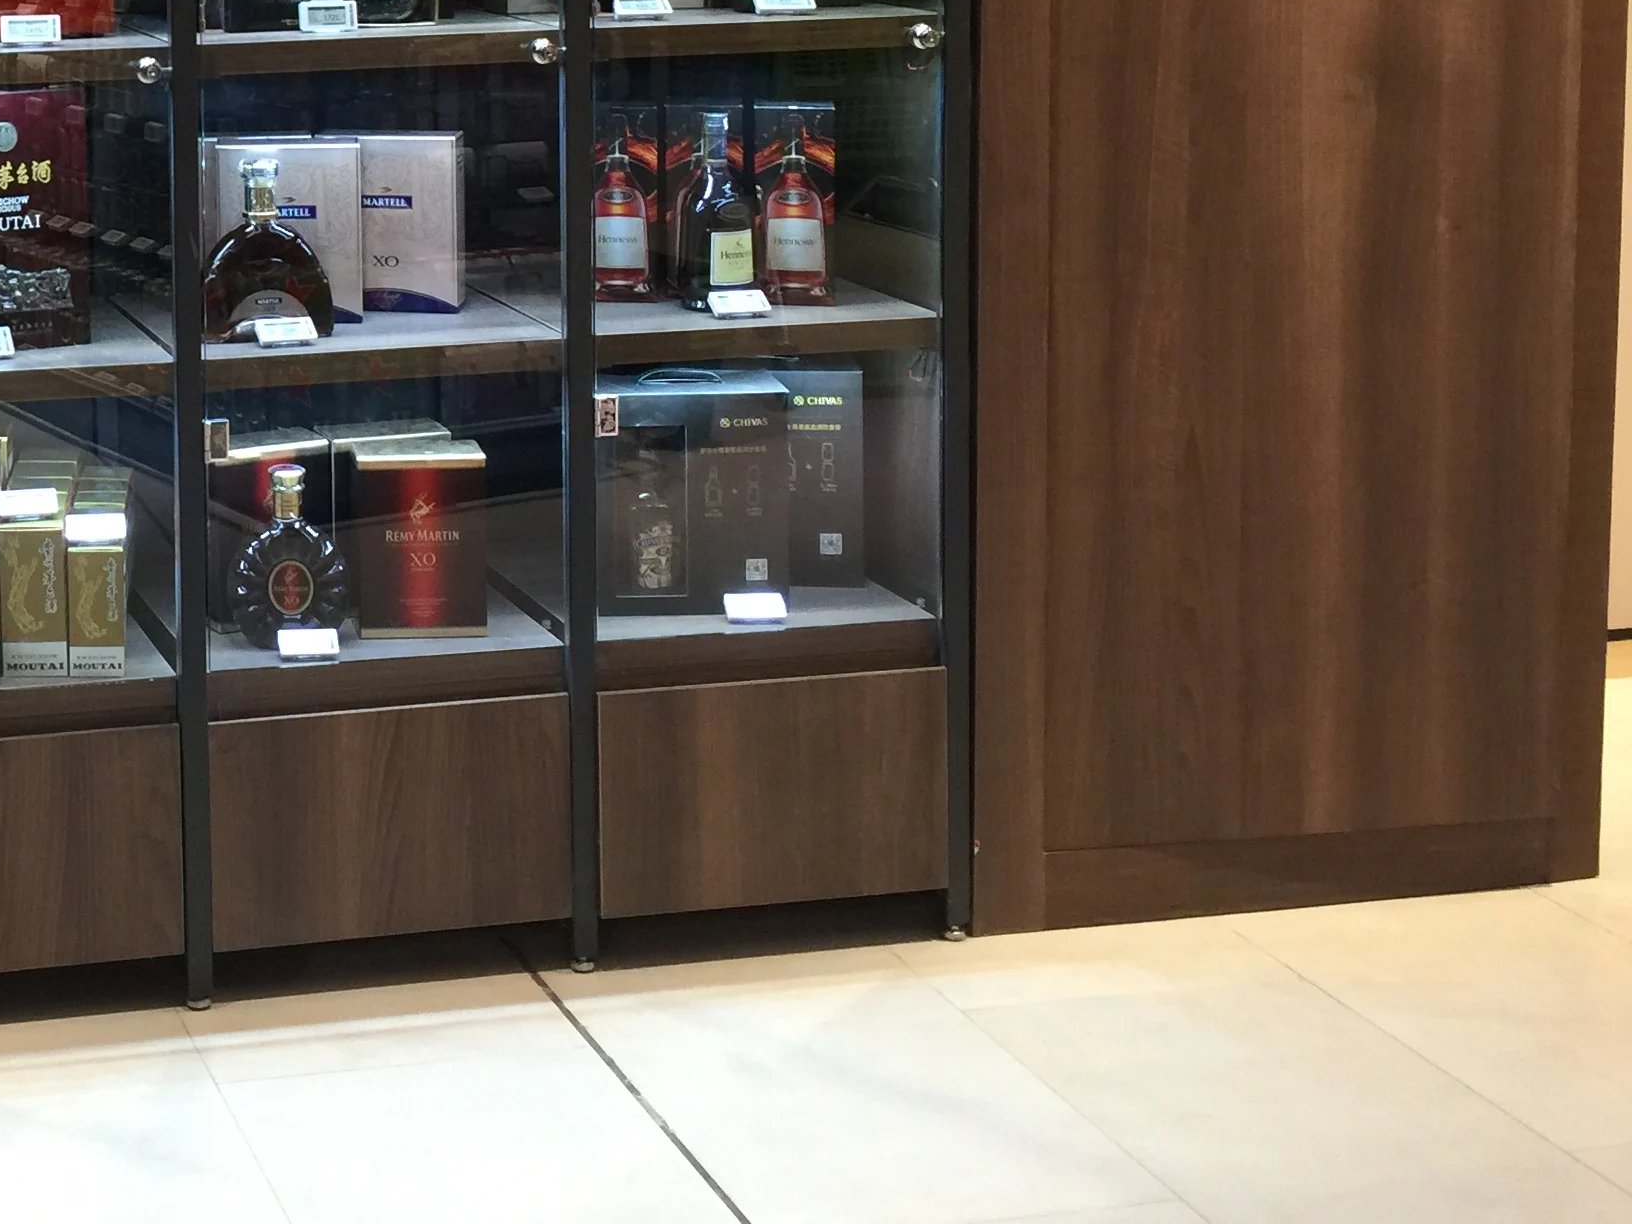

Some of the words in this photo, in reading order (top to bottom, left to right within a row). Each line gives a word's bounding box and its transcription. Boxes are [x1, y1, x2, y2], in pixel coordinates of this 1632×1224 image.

[363, 197, 408, 207] MARTELL
[278, 207, 311, 217] ARTELL
[598, 234, 637, 245] Hennessy
[773, 236, 815, 247] Hennessy
[372, 255, 400, 268] XO
[807, 396, 843, 406] CHIVAS
[733, 417, 768, 427] CHIVAS
[417, 529, 460, 542] MARTIN
[410, 552, 437, 567] XO
[6, 662, 65, 671] MOUTAI
